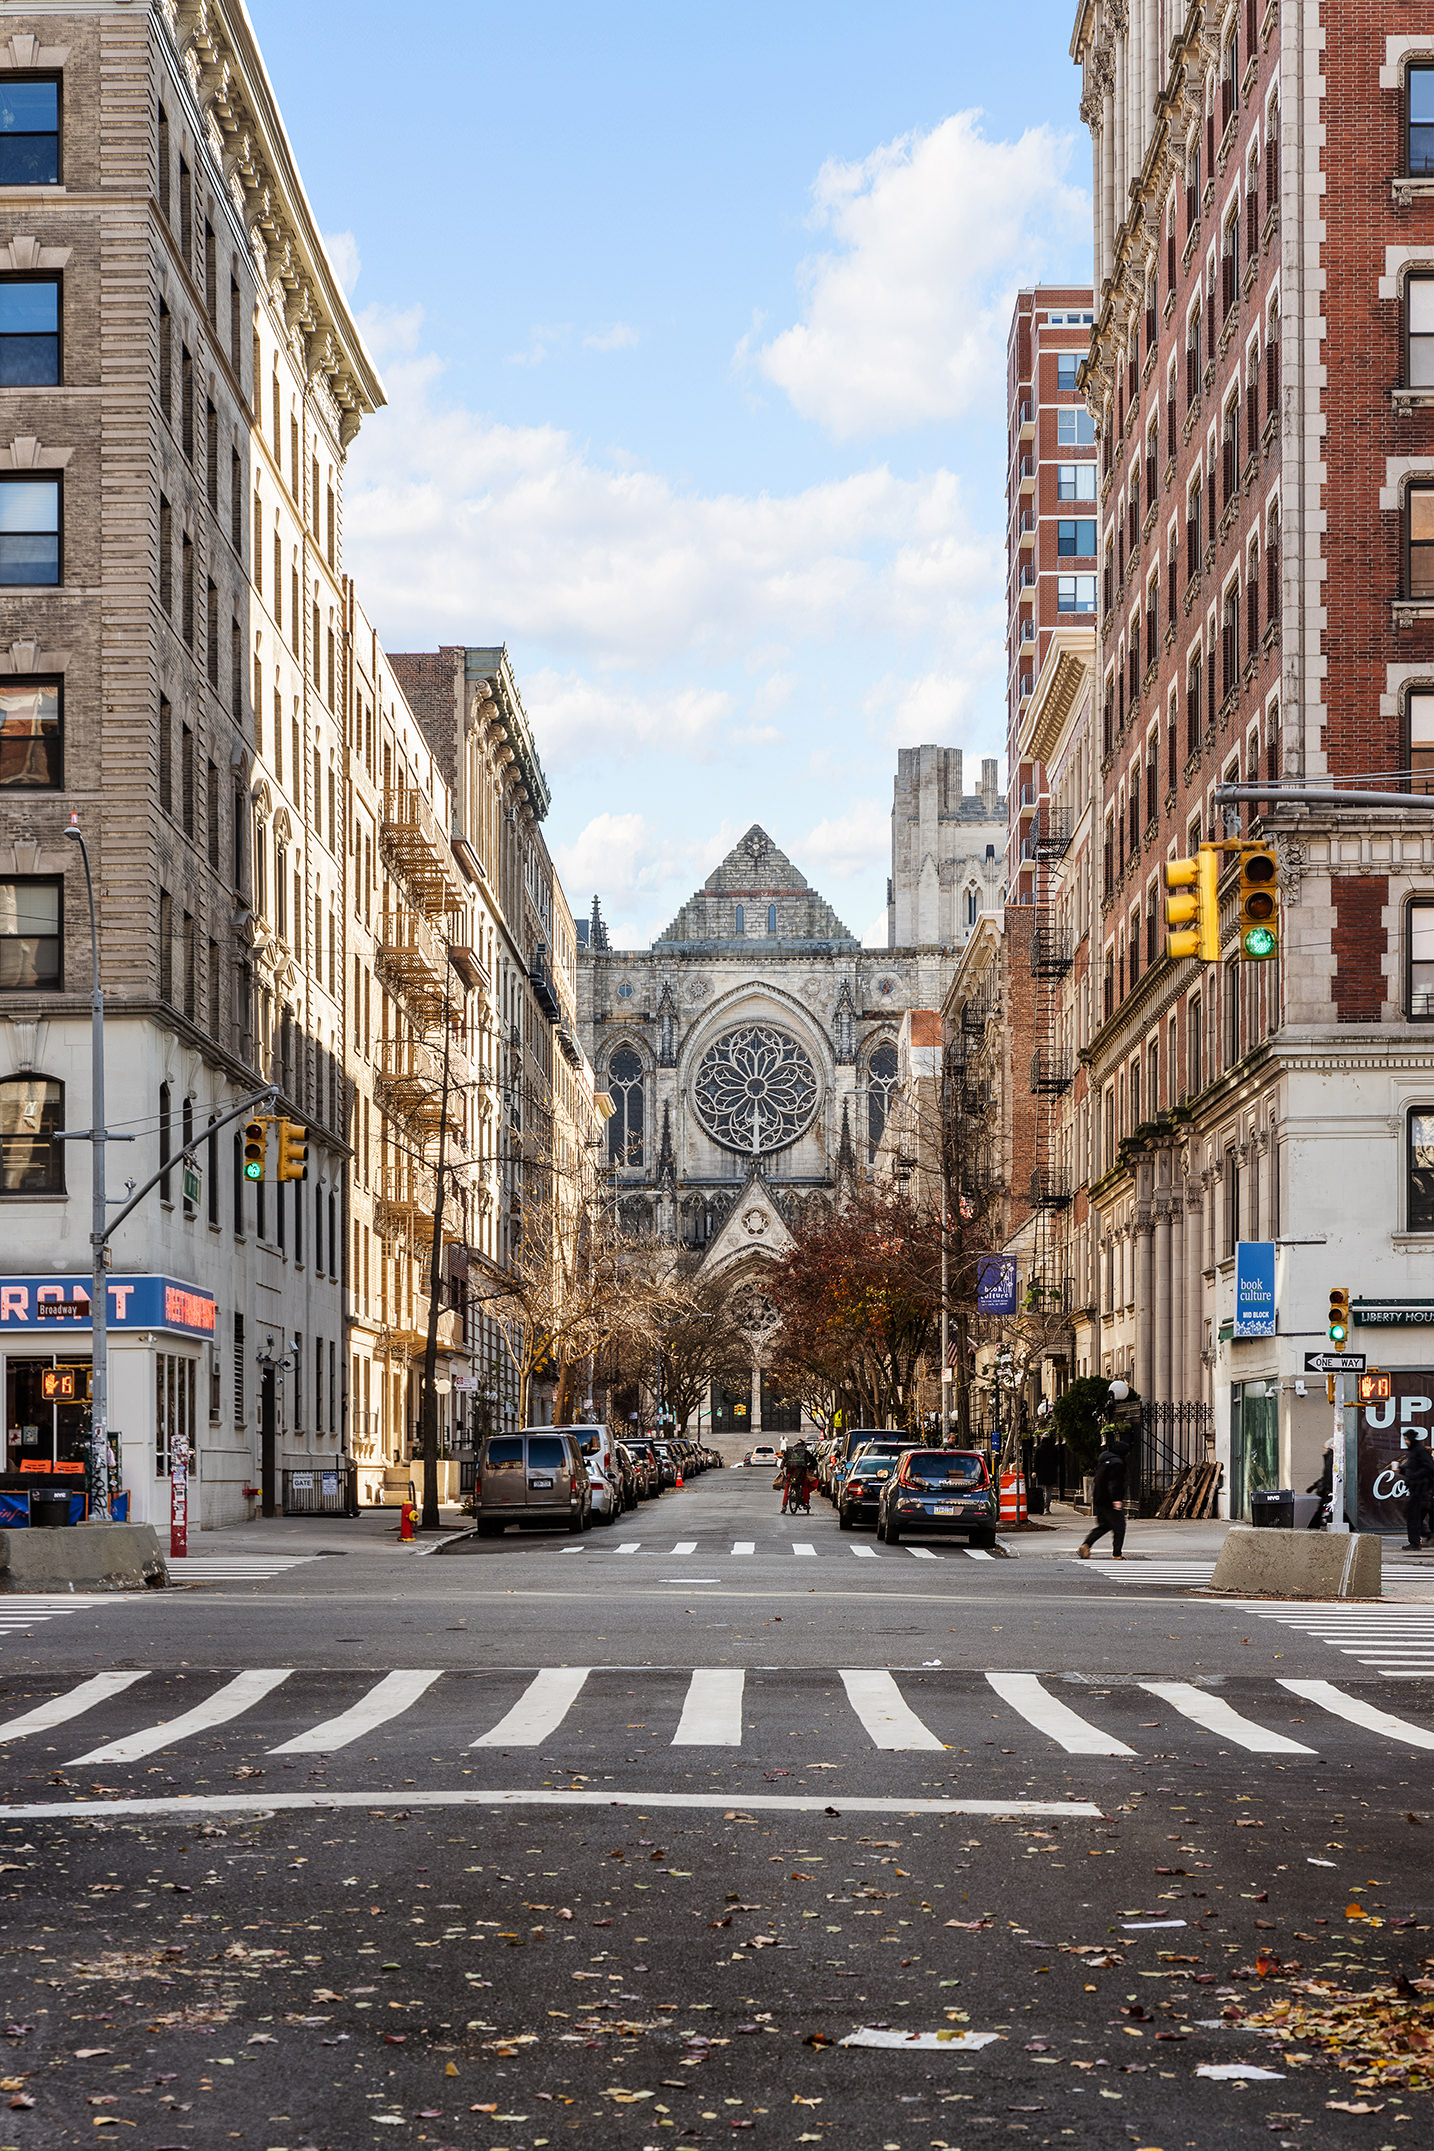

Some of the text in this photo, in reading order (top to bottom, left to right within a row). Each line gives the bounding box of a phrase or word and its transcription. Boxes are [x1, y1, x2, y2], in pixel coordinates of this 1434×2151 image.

[1240, 1278, 1263, 1290] book
[1240, 1289, 1272, 1301] culture
[39, 1304, 78, 1316] Broadway
[1361, 1312, 1434, 1322] LIBERTY HOU
[1316, 1358, 1360, 1368] ONE WAY
